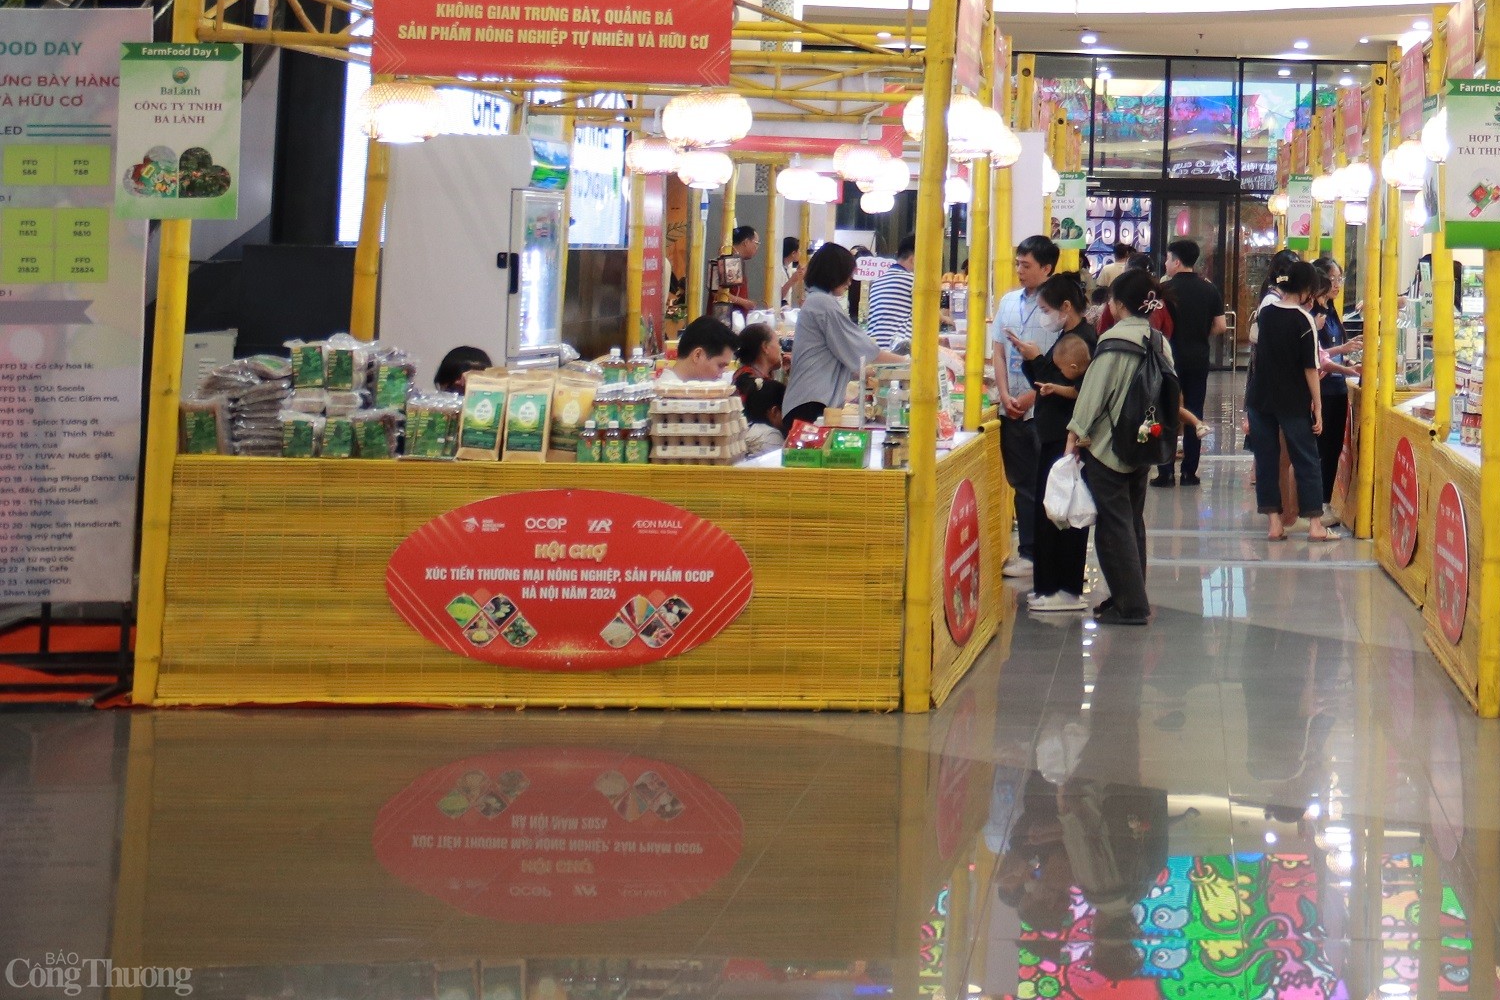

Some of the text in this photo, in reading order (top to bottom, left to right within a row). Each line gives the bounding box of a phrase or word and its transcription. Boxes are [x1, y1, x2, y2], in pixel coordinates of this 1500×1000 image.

[436, 0, 673, 26] KHÔNG GIAN TRƯNG BÀY, QUẢNG BÁ
[397, 22, 709, 49] SẢN PHẨM NÔNG NGHIỆP TỰ NHIÊN VÀ HỮU CƠ
[44, 41, 82, 55] DAY
[142, 47, 190, 55] FarmFood
[192, 47, 211, 58] Day
[37, 73, 70, 86] BÀY
[18, 93, 82, 106] HỮU CƠ
[134, 101, 221, 110] CÔNG TY TNHH
[173, 115, 204, 123] LÀNH
[1469, 134, 1491, 142] HỢP
[1459, 146, 1474, 154] TÀI
[525, 517, 567, 529] OCOP
[534, 540, 607, 562] HỘI CHỢ
[425, 566, 714, 584] XÚC TIẾN THƯƠNG MẠI NÔNG NGHIỆP, SẢN PHẨM OCOP
[522, 586, 616, 601] HÀ NỘI NĂM 2024
